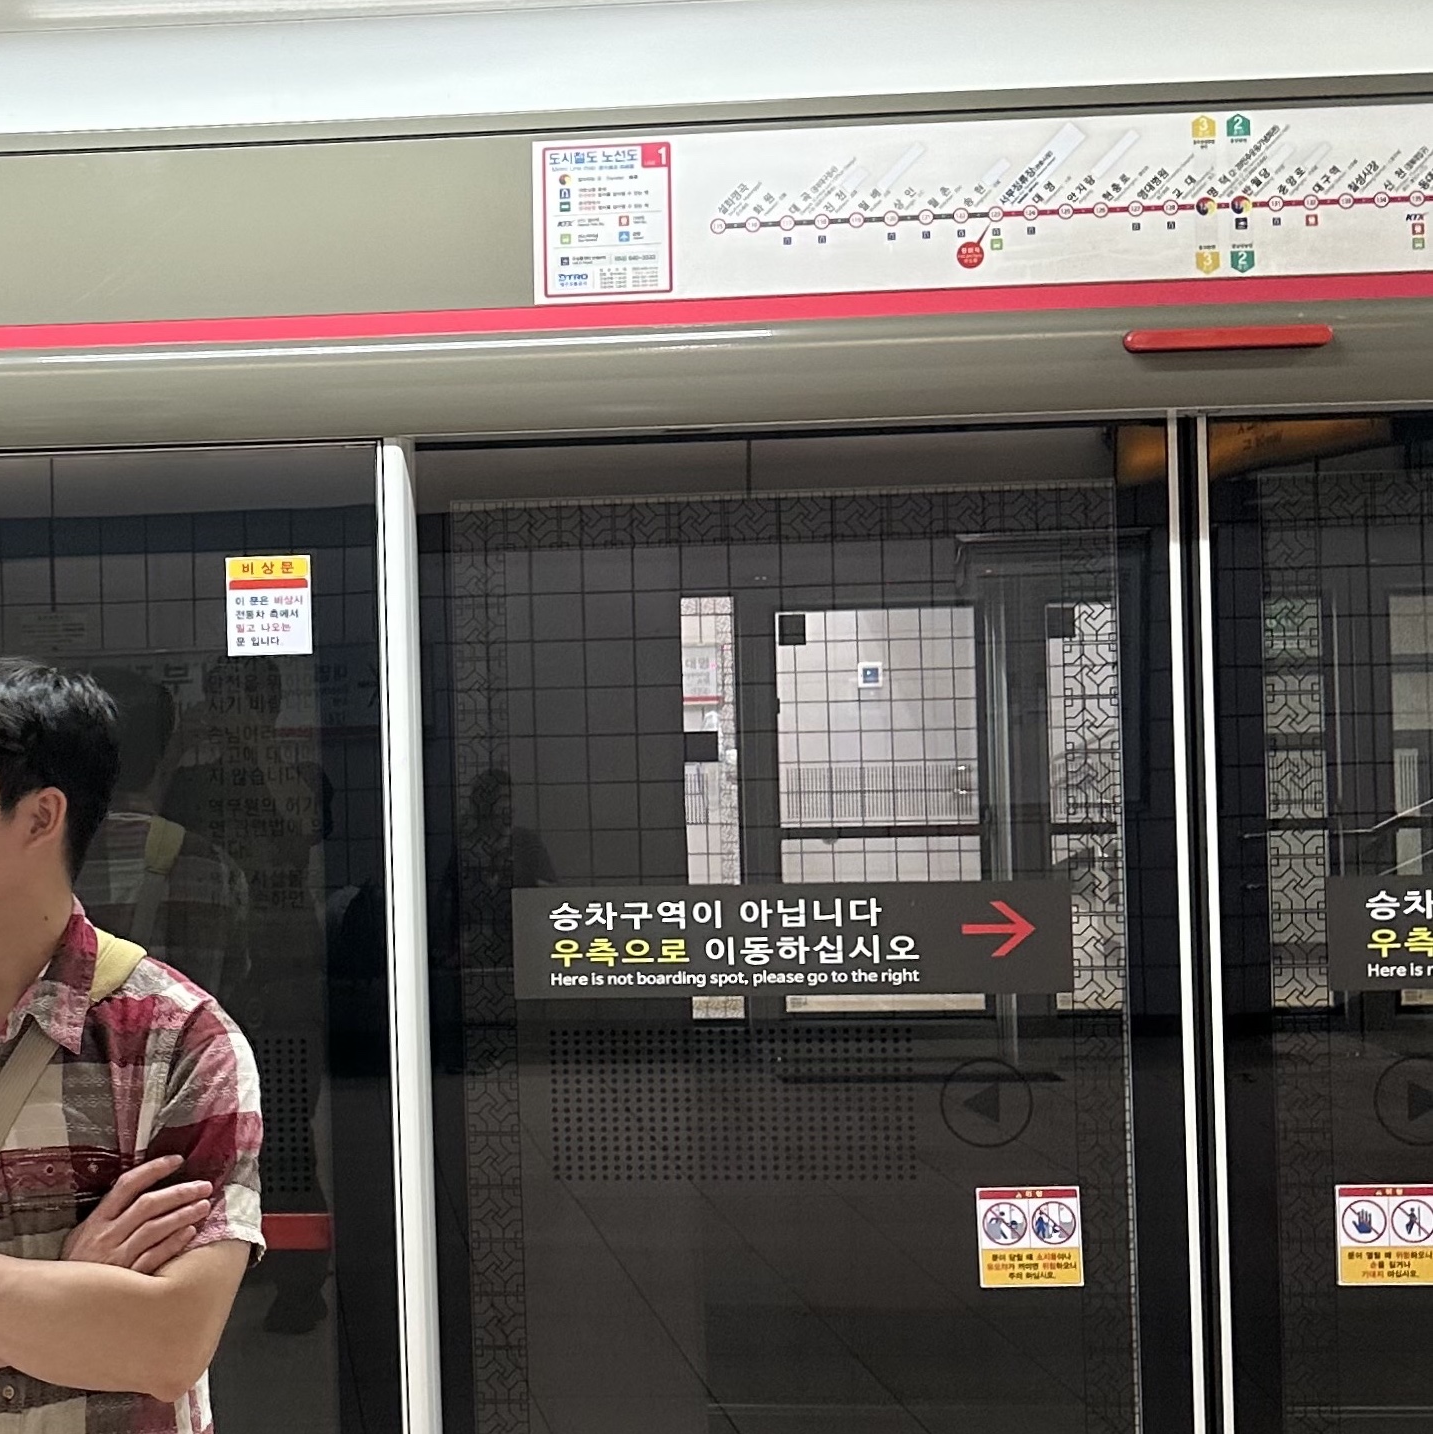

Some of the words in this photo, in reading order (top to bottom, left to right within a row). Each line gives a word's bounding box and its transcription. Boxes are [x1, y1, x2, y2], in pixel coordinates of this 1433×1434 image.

[1199, 117, 1209, 131] 3
[1233, 116, 1243, 130] 2
[601, 149, 638, 163] 노선도
[657, 146, 667, 165] 1
[999, 167, 1036, 205] 서부정류장
[1137, 168, 1170, 200] 영대병원
[1172, 174, 1197, 199] 교대
[1242, 168, 1271, 197] 반월당
[1312, 165, 1342, 193] 대구역
[1383, 169, 1407, 192] 신천
[1032, 181, 1056, 204] 대명
[1238, 251, 1247, 265] 2
[241, 561, 294, 575] 비상문
[235, 597, 245, 606] 이
[249, 596, 269, 606] 문은
[273, 595, 304, 605] 비상시
[235, 609, 266, 620] 전동차
[269, 608, 299, 619] 측에서
[260, 622, 291, 632] 나오는
[236, 636, 246, 647] 문
[549, 900, 722, 932] 승차구역이
[739, 897, 883, 929] 아닙니다
[550, 936, 690, 968] 우측으로
[705, 934, 920, 966] 이동하십시오
[550, 972, 589, 987] Here
[591, 972, 605, 986] is
[607, 973, 634, 987] not
[636, 970, 706, 988] boarding
[709, 971, 749, 989] spot,
[752, 969, 805, 988] please
[806, 973, 829, 988] go
[830, 970, 849, 984] to
[850, 968, 879, 984] the
[881, 968, 920, 988] right
[1367, 963, 1407, 977] Here
[1409, 962, 1424, 977] is
